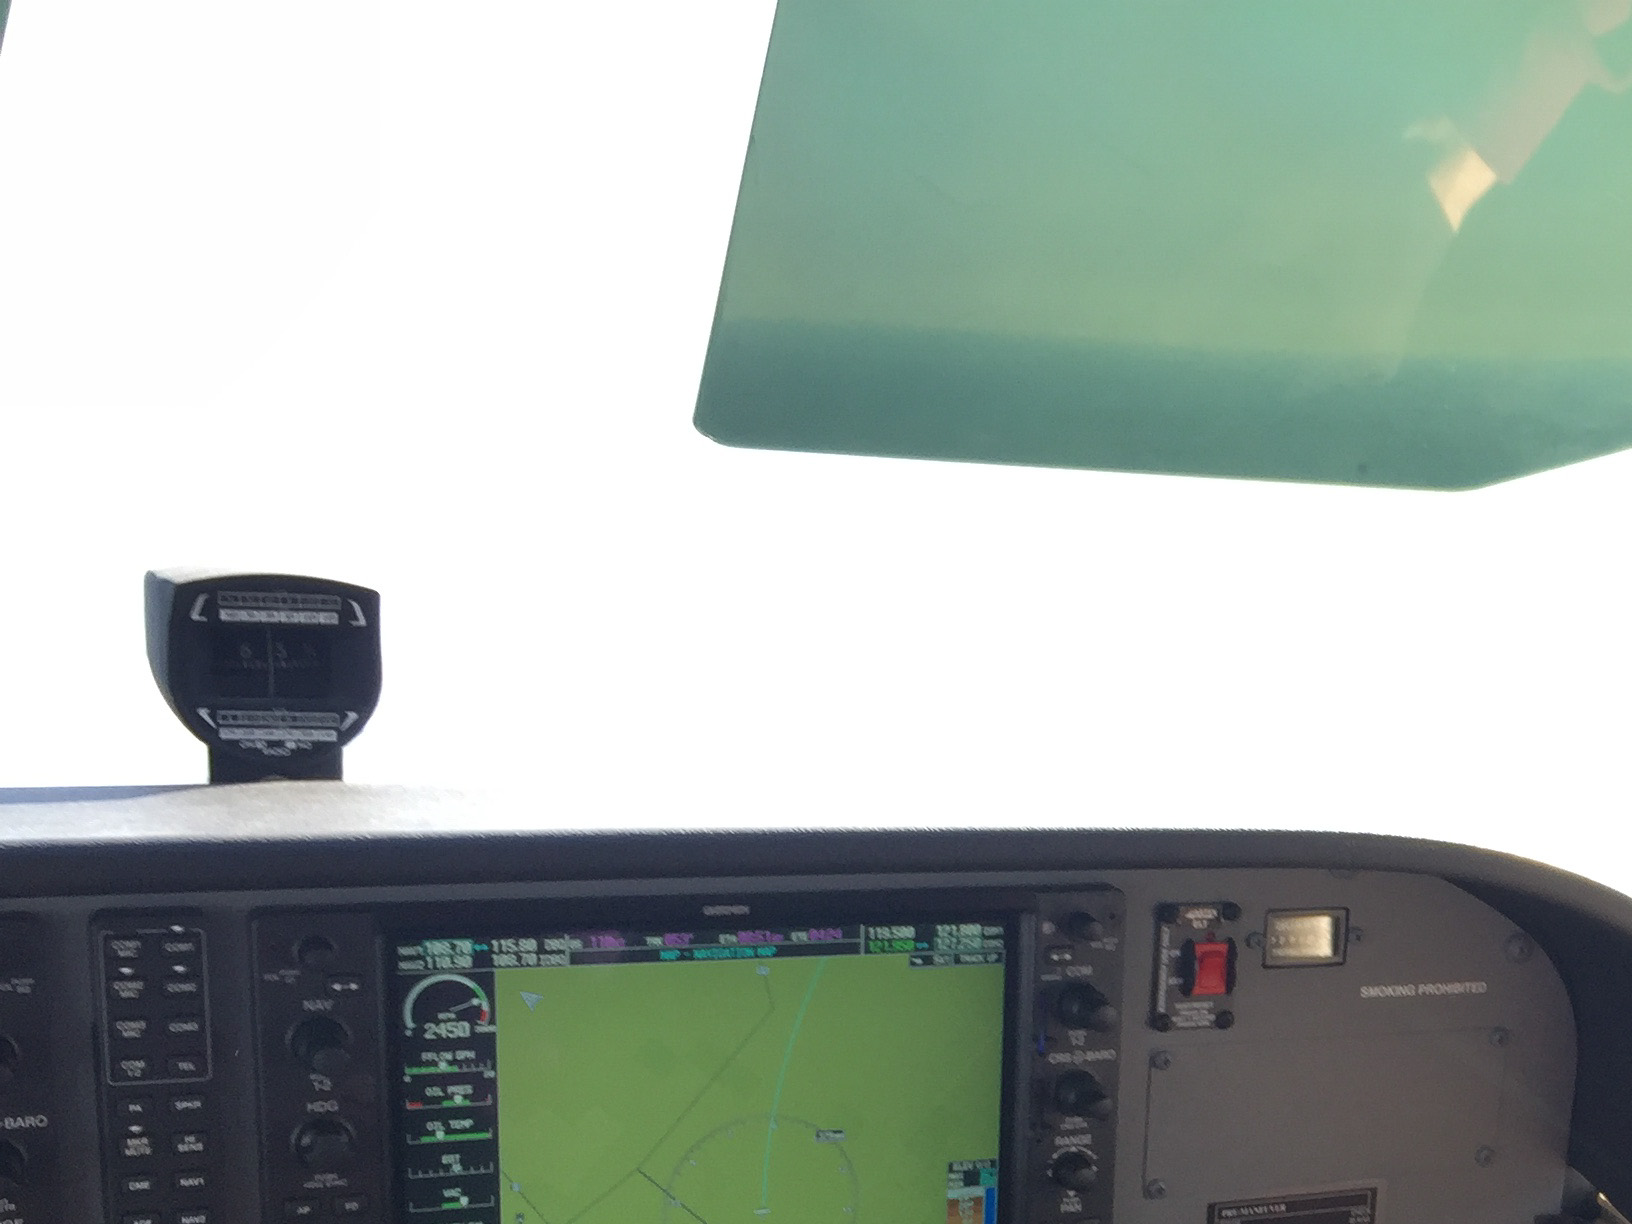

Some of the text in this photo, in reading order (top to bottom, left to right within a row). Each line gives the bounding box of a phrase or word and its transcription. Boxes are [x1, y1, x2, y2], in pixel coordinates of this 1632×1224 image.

[1360, 981, 1487, 998] SMOKING PROHIBITED
[423, 1021, 471, 1039] 2450
[4, 1114, 48, 1129] BARO
